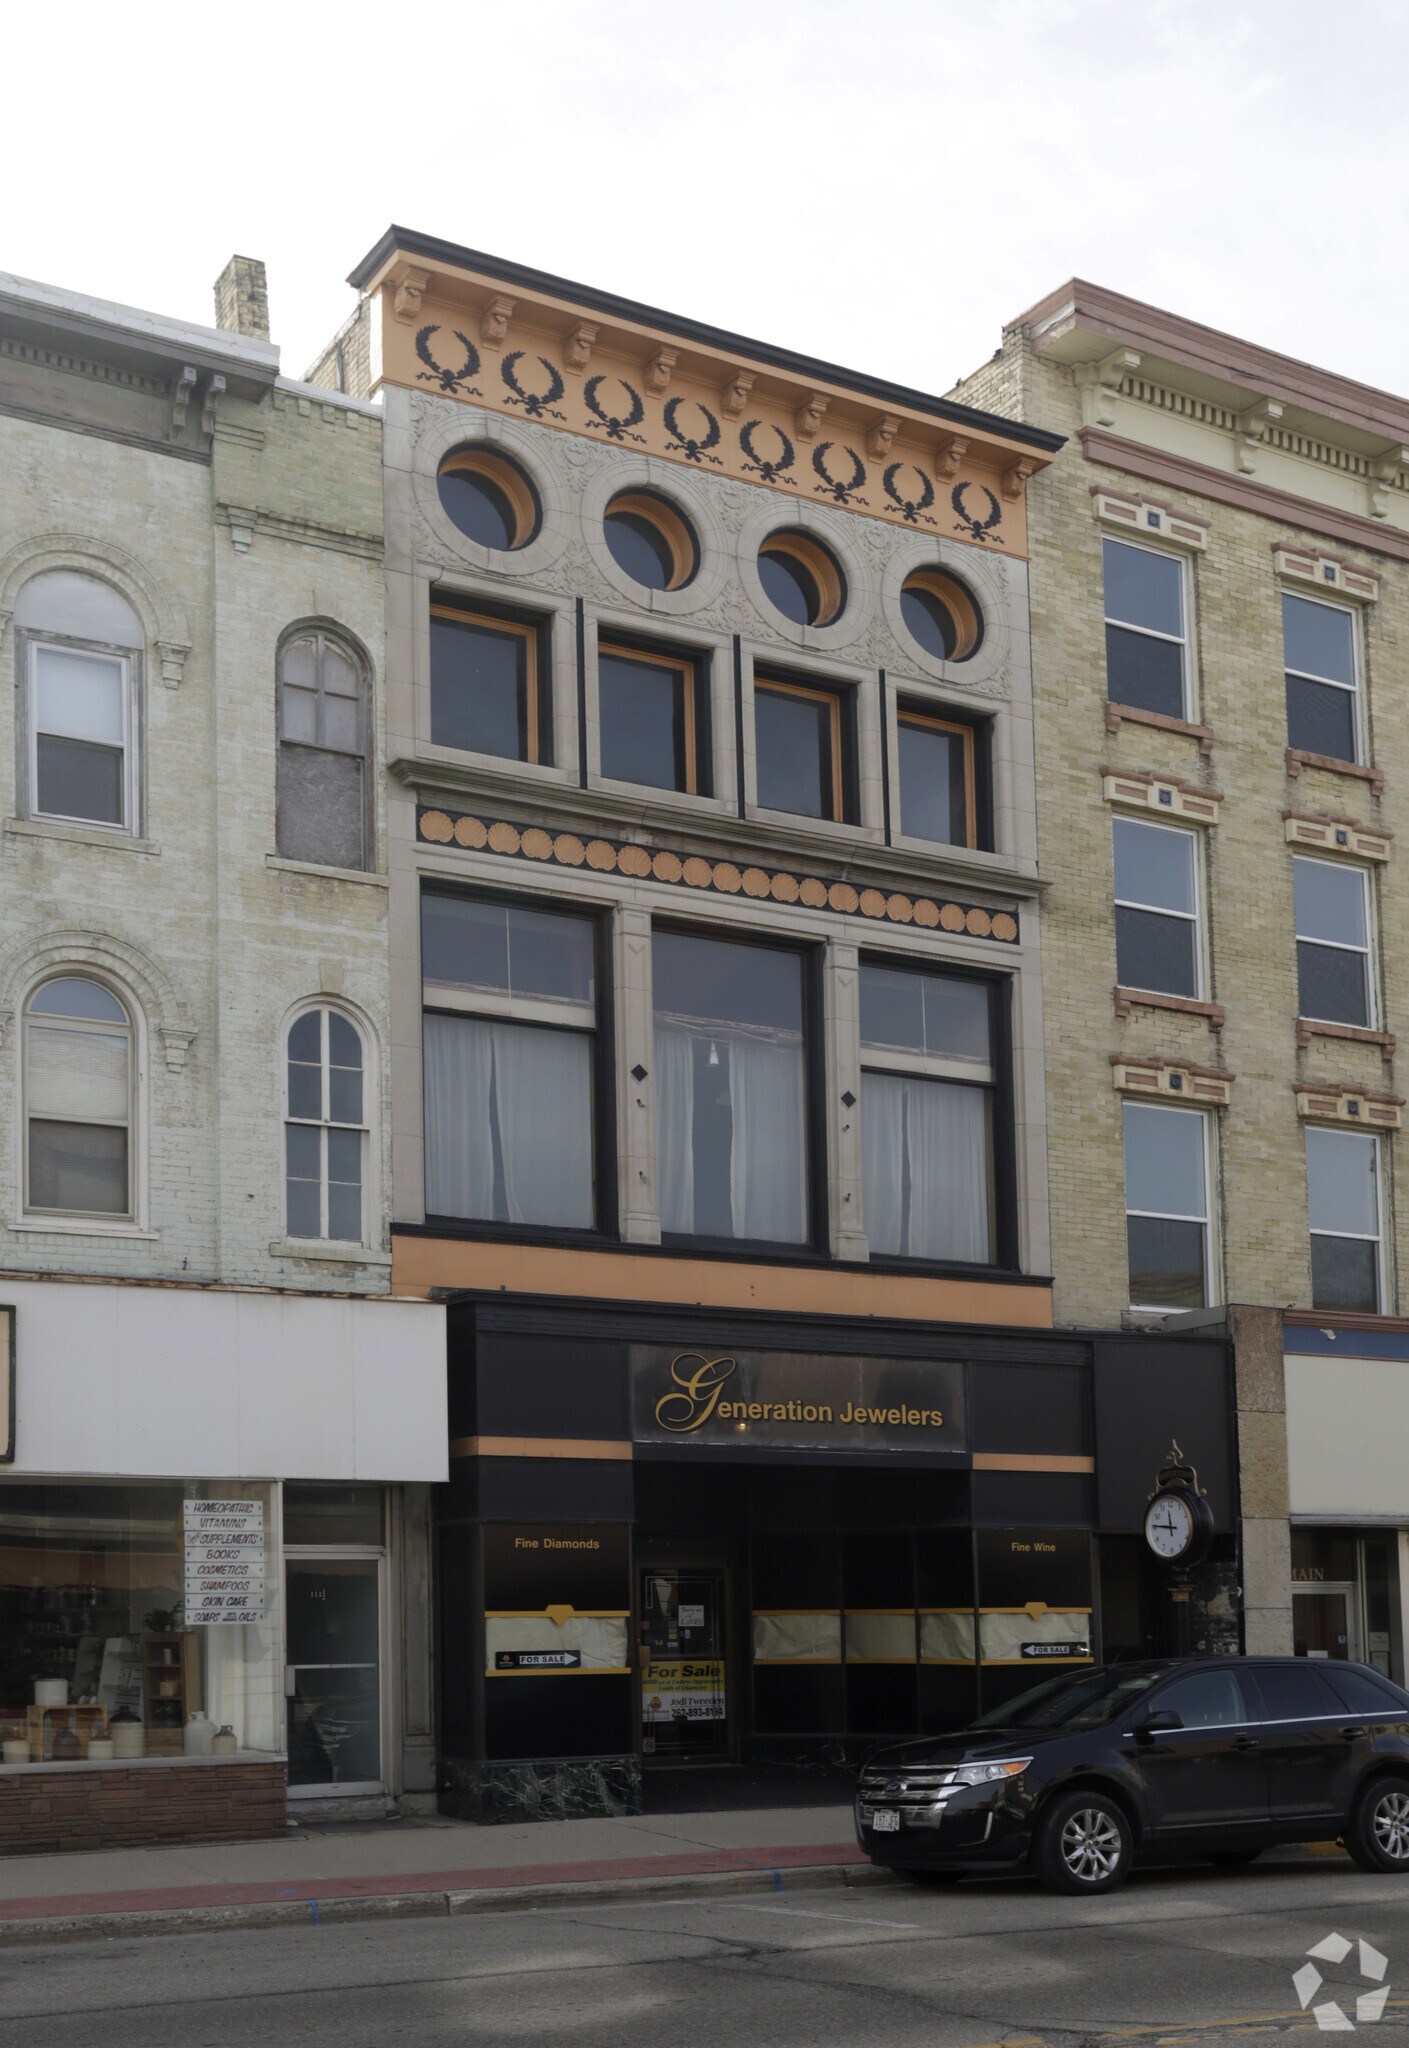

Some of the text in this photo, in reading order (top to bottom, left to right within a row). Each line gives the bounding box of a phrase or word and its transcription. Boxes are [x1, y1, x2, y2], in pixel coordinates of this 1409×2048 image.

[655, 1352, 944, 1432] Generation Jewelers
[194, 1503, 253, 1513] HOMEOPATHIC
[200, 1518, 247, 1528] VITAMINS
[200, 1534, 259, 1544] SUPPLEMENTS
[514, 1537, 600, 1549] Fine Diamonds
[1011, 1542, 1056, 1552] Fine Wine
[206, 1549, 241, 1559] BOOKS
[197, 1565, 249, 1575] COSMETICS
[200, 1581, 250, 1591] SHAMPOOS
[202, 1597, 248, 1606] SKIN CARE
[194, 1612, 220, 1622] SOAPS
[238, 1612, 257, 1622] OILS
[648, 1664, 720, 1678] For Sale
[670, 1697, 687, 1706] Jodi
